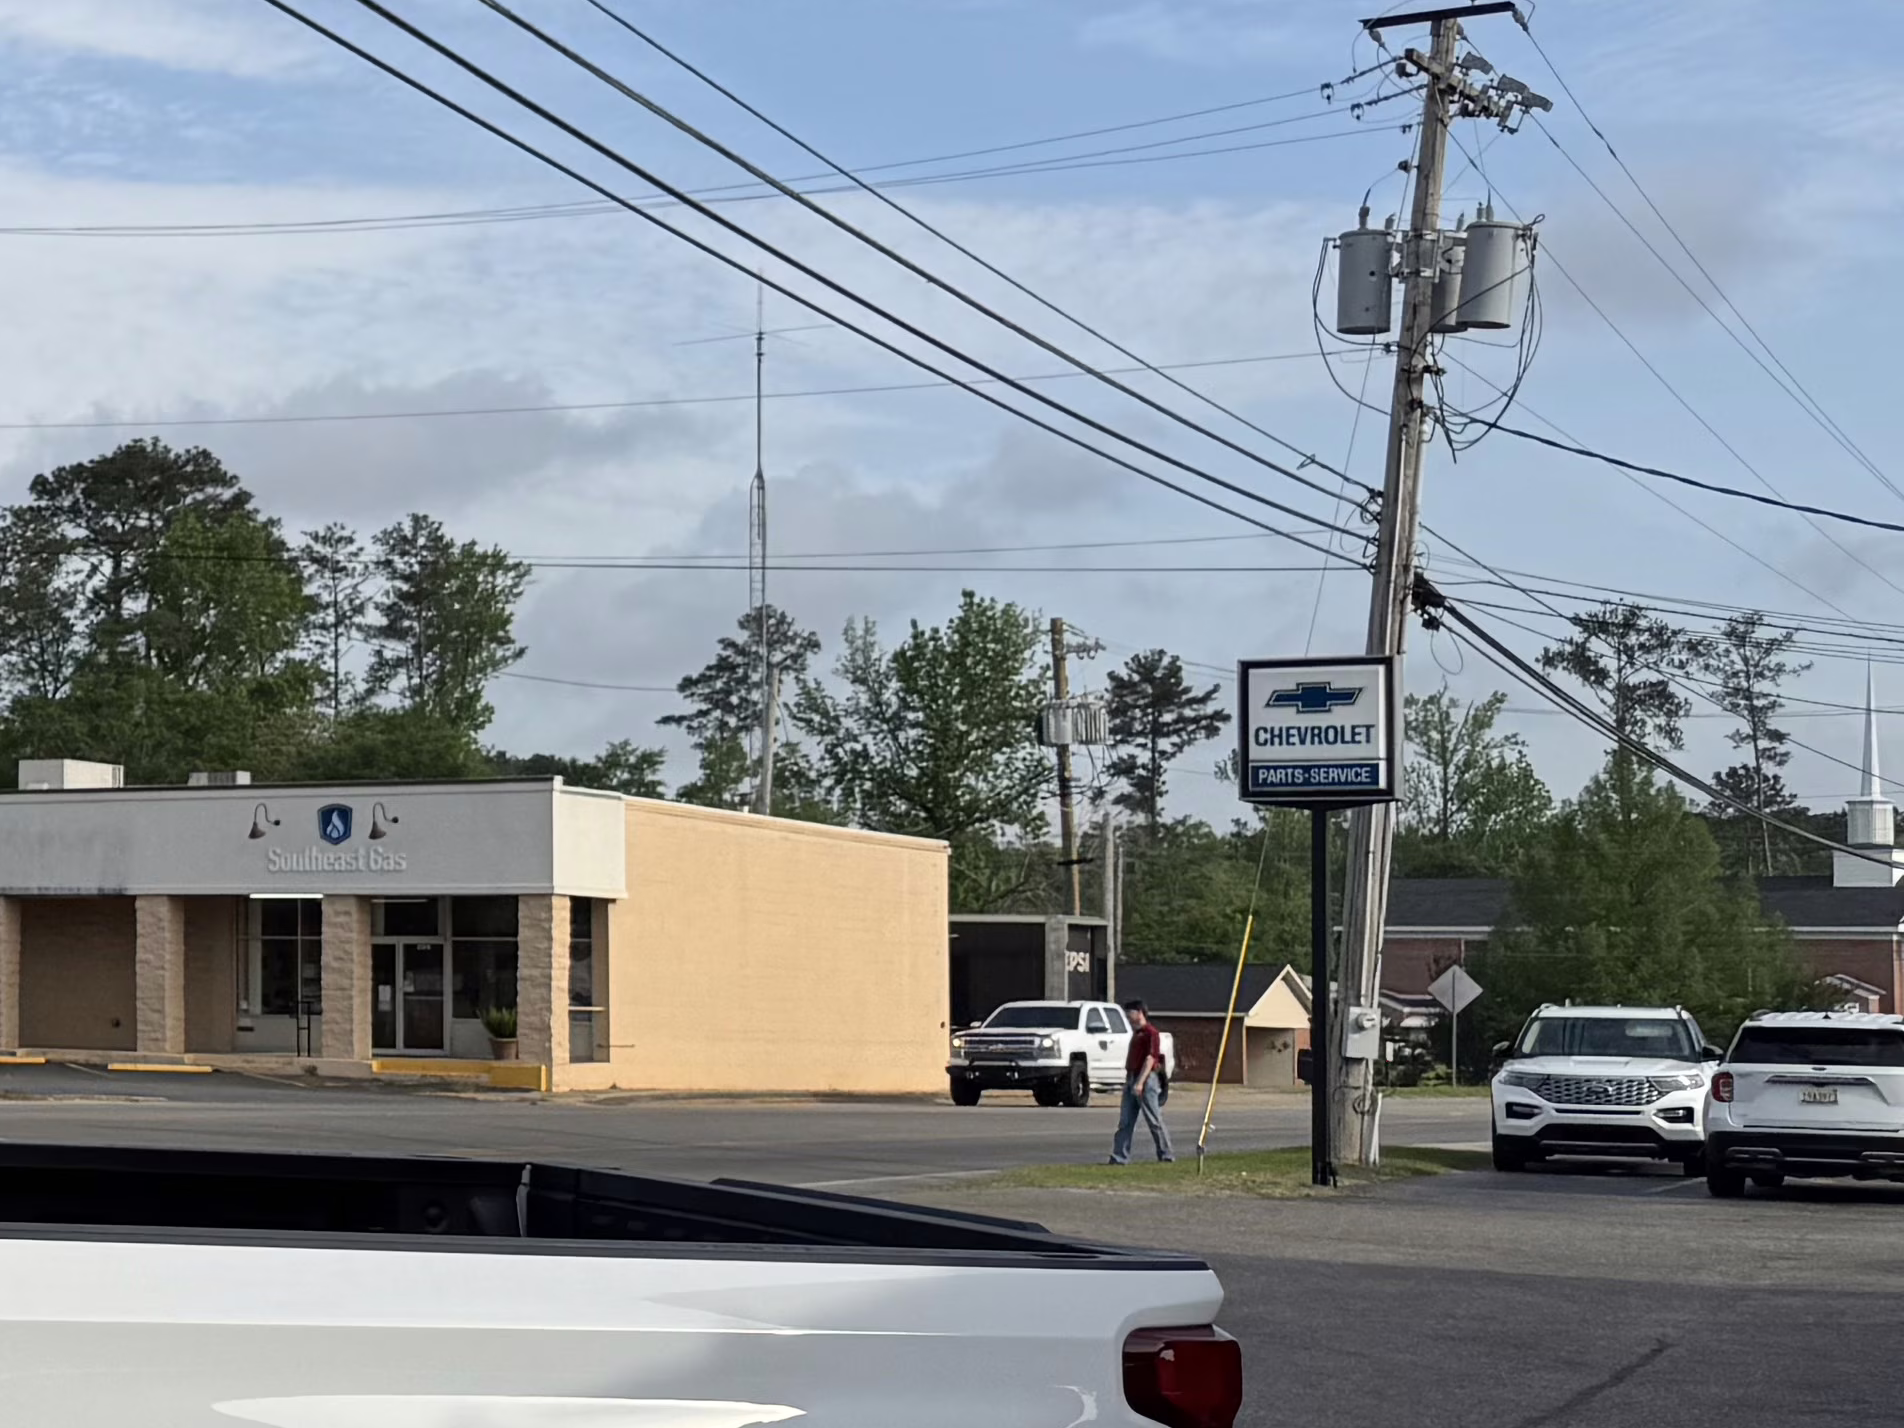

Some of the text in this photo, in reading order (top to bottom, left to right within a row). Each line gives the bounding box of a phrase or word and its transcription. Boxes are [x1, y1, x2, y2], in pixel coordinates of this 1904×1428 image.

[1254, 724, 1375, 746] CHEVROLET
[268, 845, 407, 872] Southeast Gas
